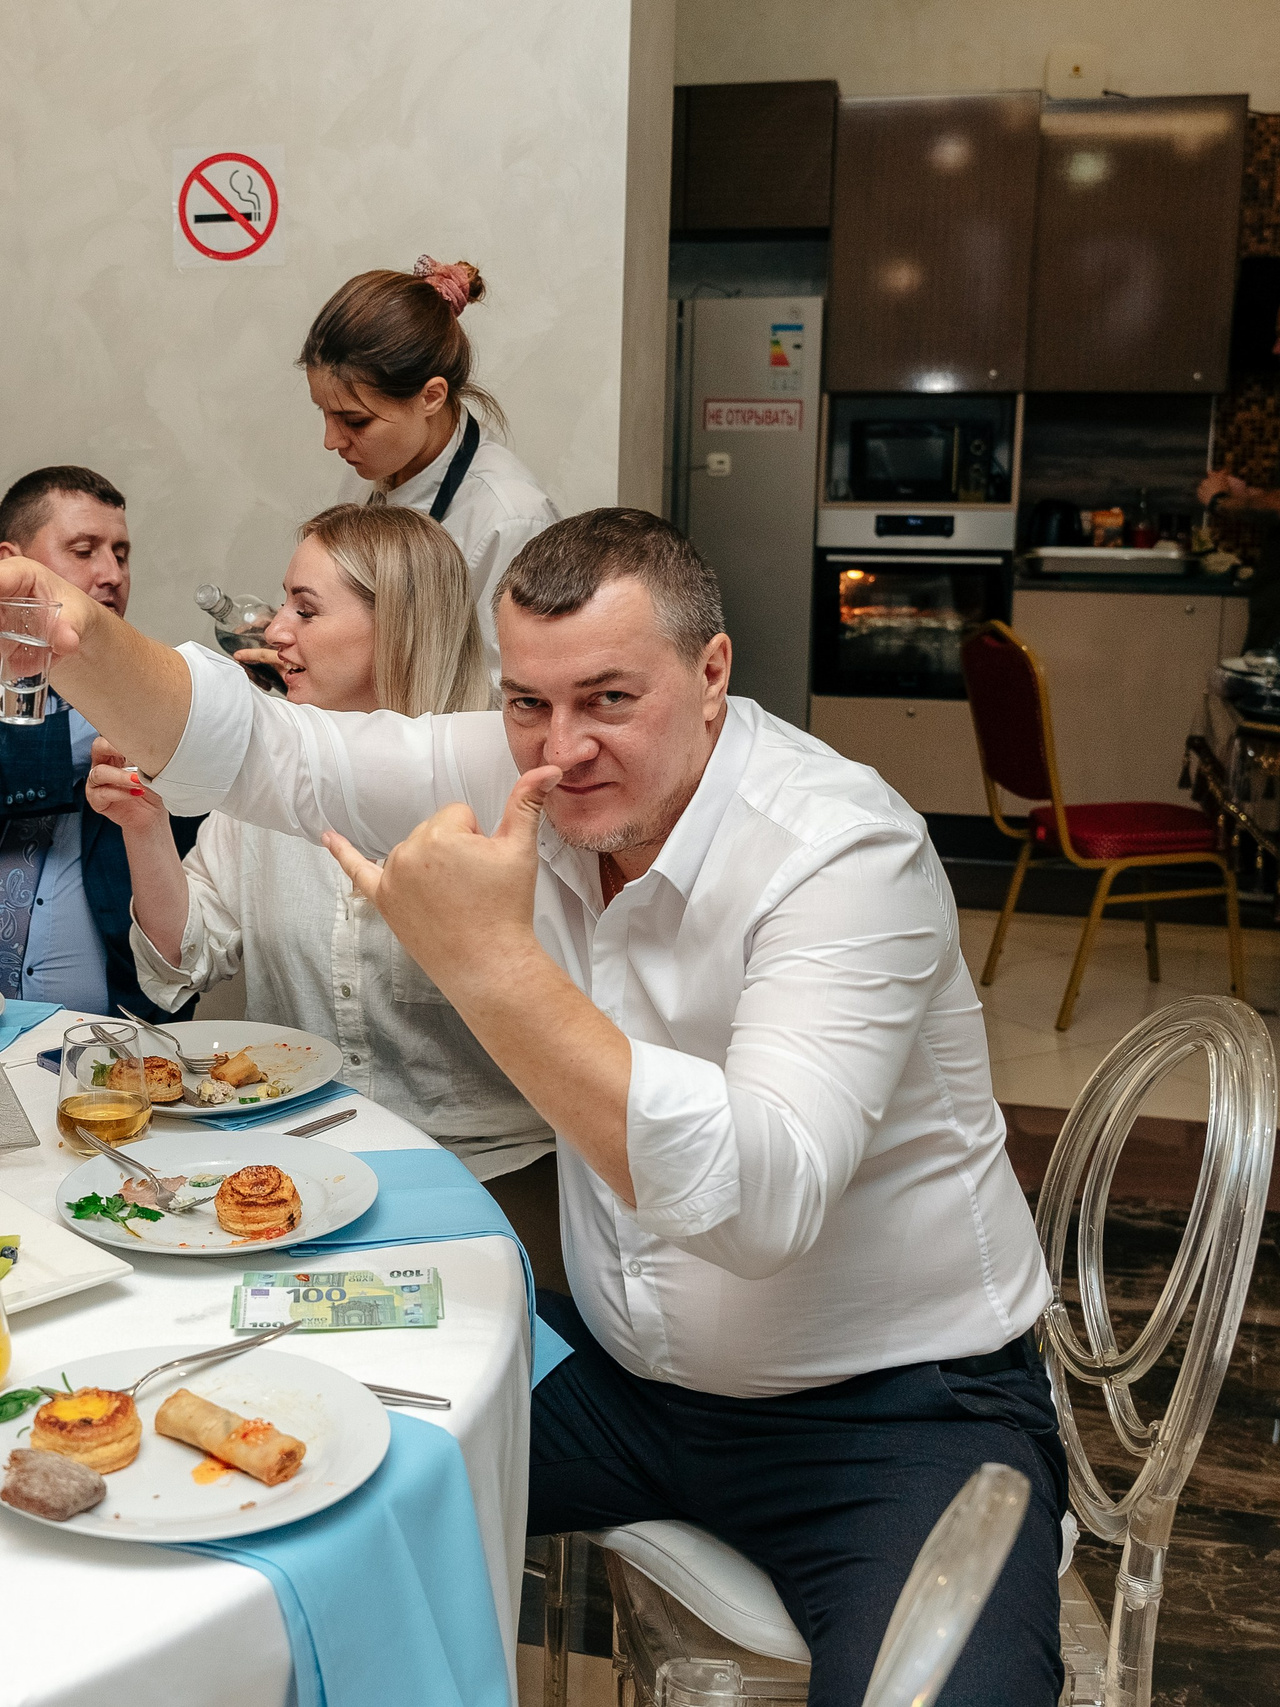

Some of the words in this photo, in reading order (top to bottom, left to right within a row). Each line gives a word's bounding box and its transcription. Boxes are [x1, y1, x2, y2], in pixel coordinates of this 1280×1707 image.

[707, 408, 724, 425] НЕ
[389, 1269, 424, 1278] 100
[286, 1287, 347, 1303] 100
